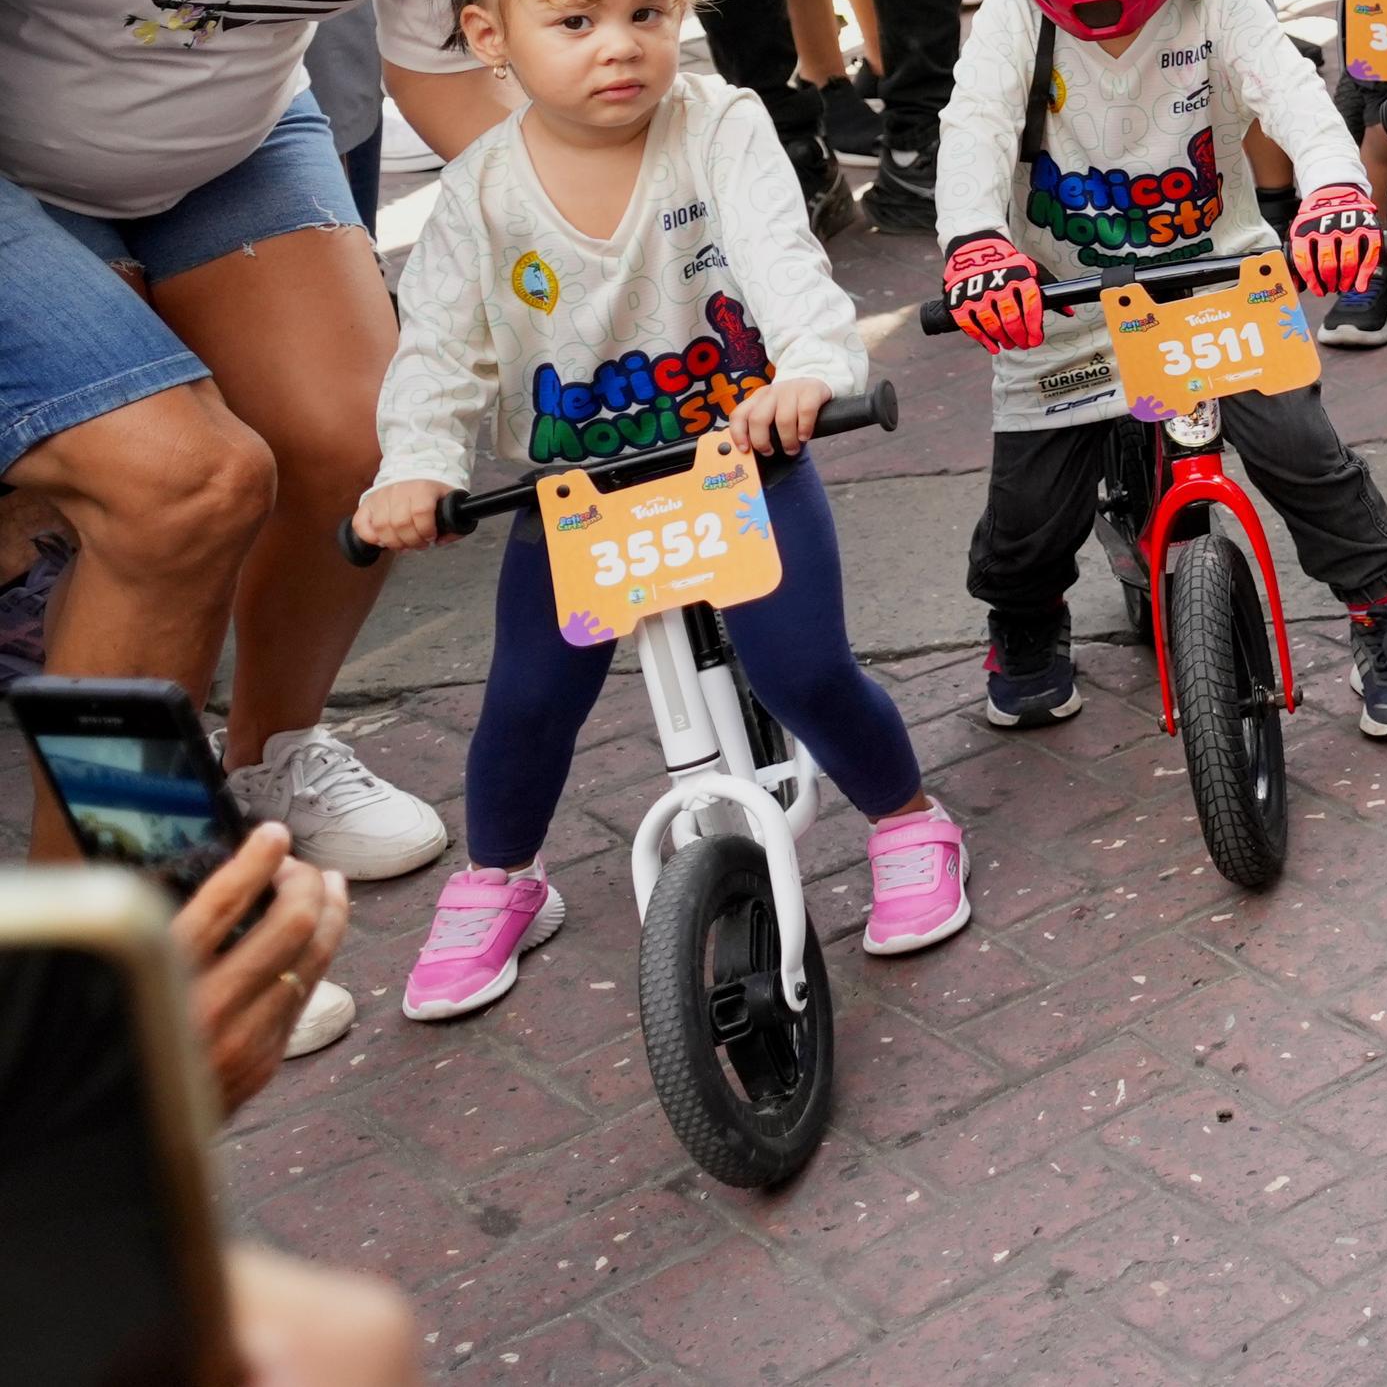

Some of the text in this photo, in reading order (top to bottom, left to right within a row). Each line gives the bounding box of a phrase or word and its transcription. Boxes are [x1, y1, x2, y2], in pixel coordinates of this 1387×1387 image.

[1031, 150, 1196, 212] Retico
[1319, 209, 1377, 234] FOX
[950, 268, 1008, 306] FOX
[1158, 322, 1265, 375] 3511
[1038, 366, 1110, 390] TURISMO
[1045, 389, 1117, 416] IDER
[590, 512, 728, 586] 3552
